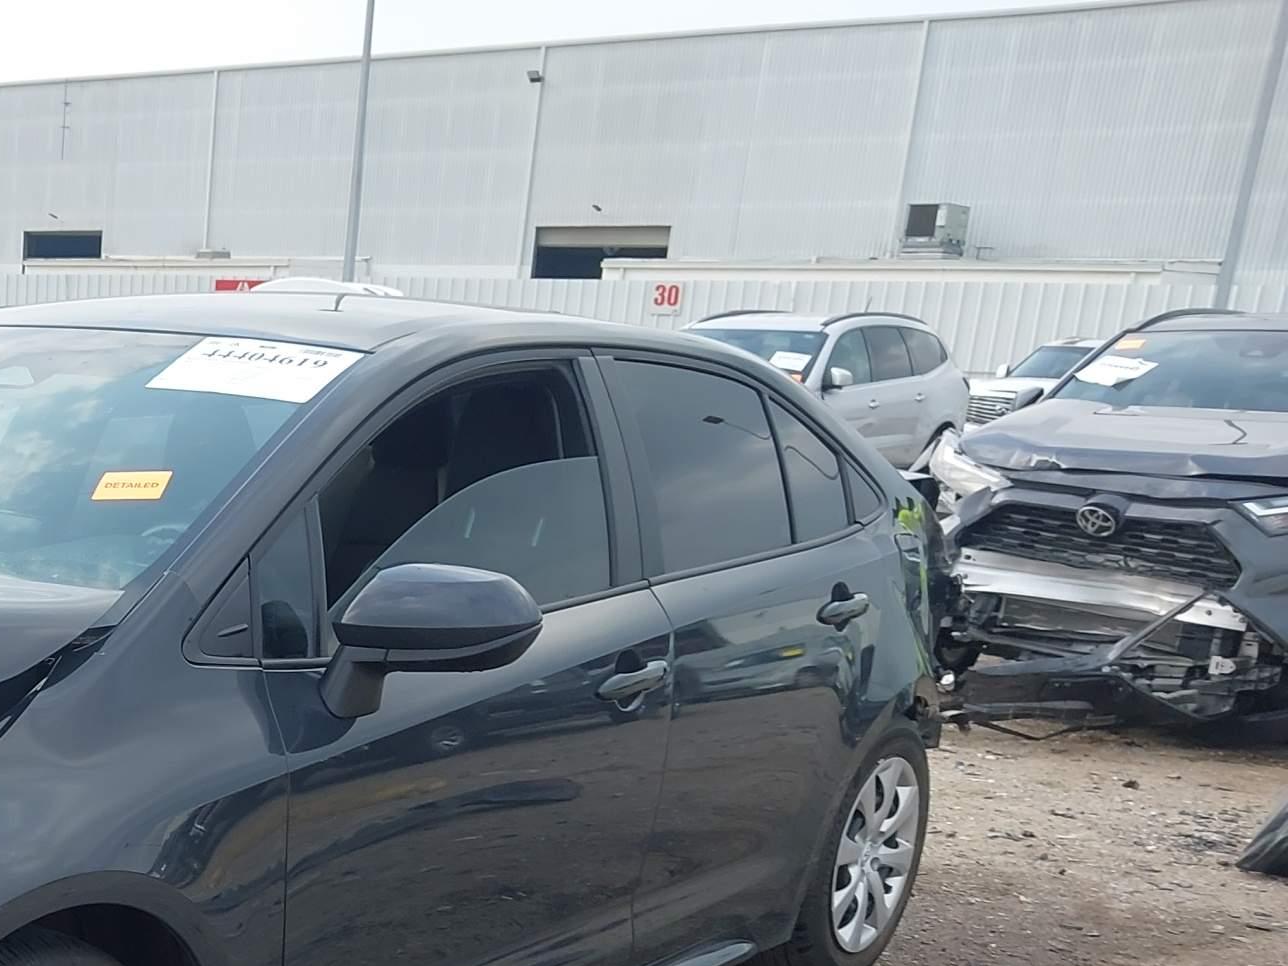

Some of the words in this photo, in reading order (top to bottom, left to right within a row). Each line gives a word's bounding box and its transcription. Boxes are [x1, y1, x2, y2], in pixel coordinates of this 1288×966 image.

[654, 284, 679, 306] 30
[201, 349, 328, 369] 44404619
[104, 481, 160, 489] DETAILED
